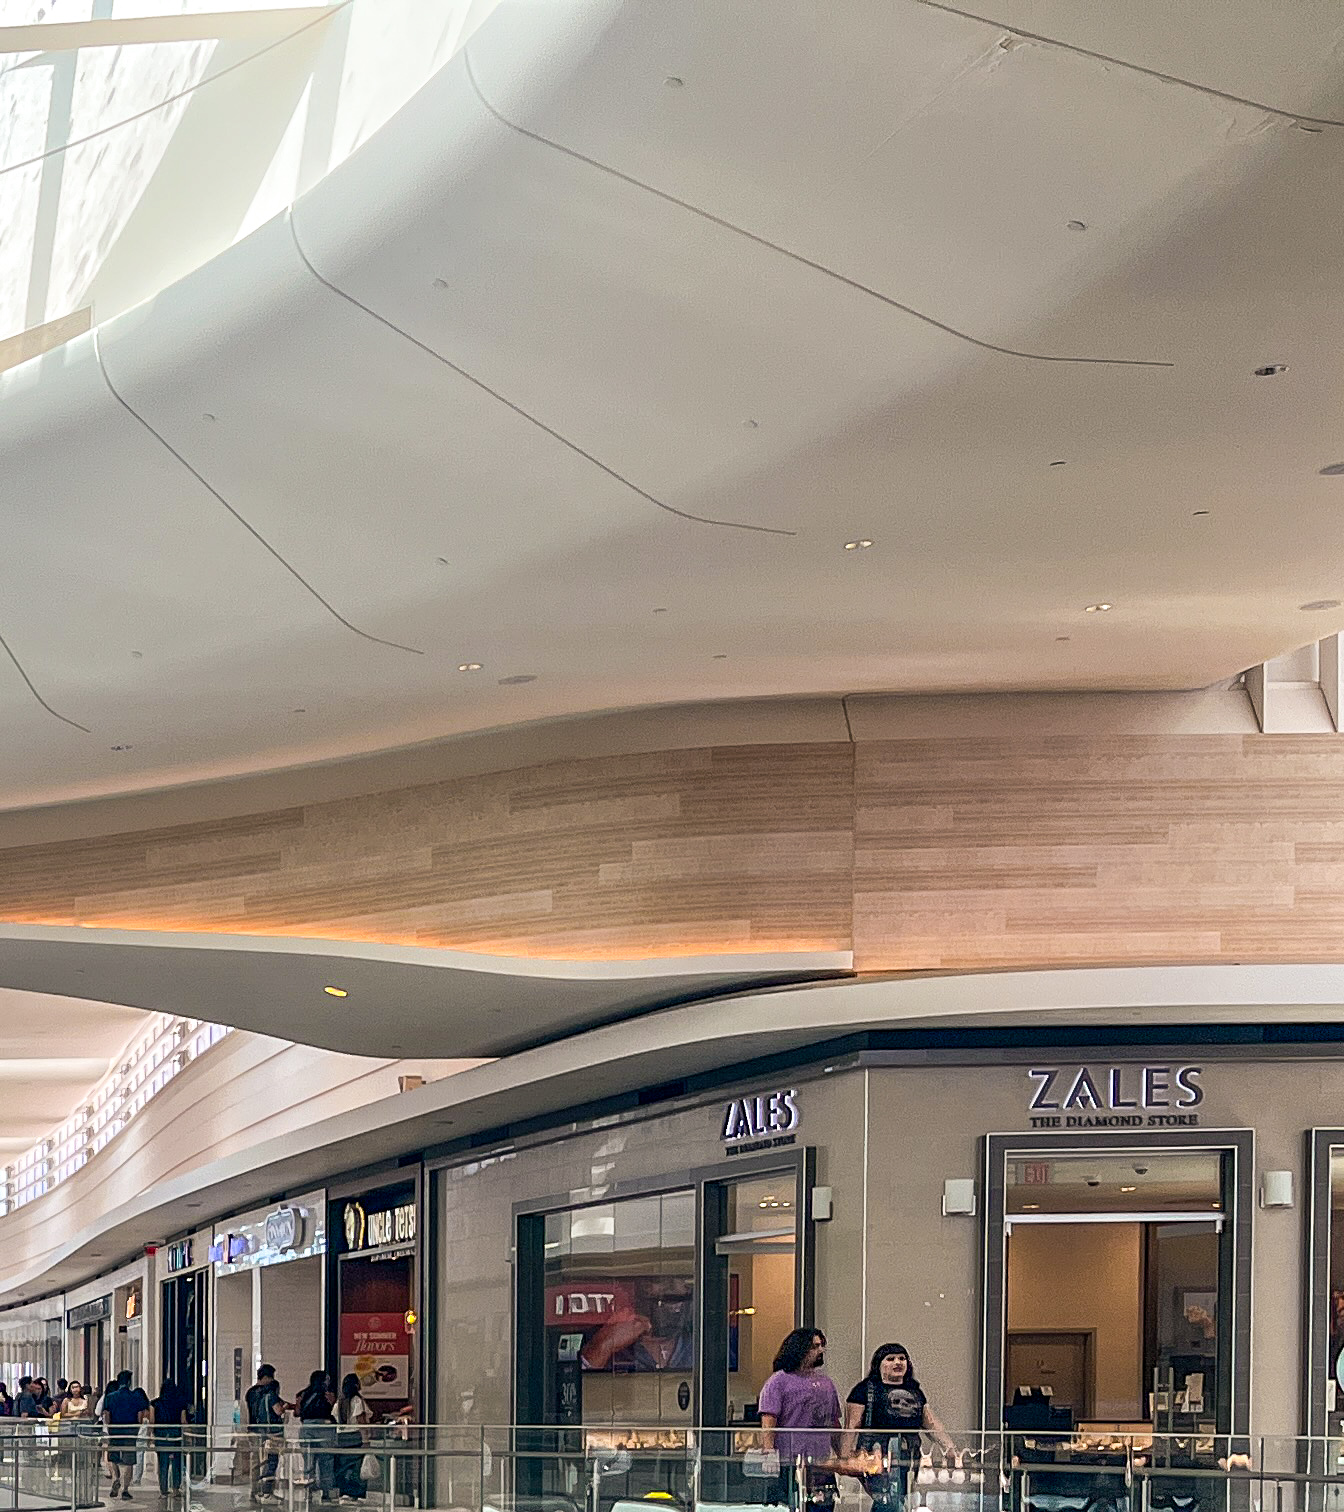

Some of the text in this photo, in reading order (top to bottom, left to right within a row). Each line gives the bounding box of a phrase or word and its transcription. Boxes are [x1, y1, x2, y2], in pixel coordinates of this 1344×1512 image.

[1028, 1066, 1204, 1110] ZALES
[1029, 1114, 1199, 1128] THE DIAMOND STORE
